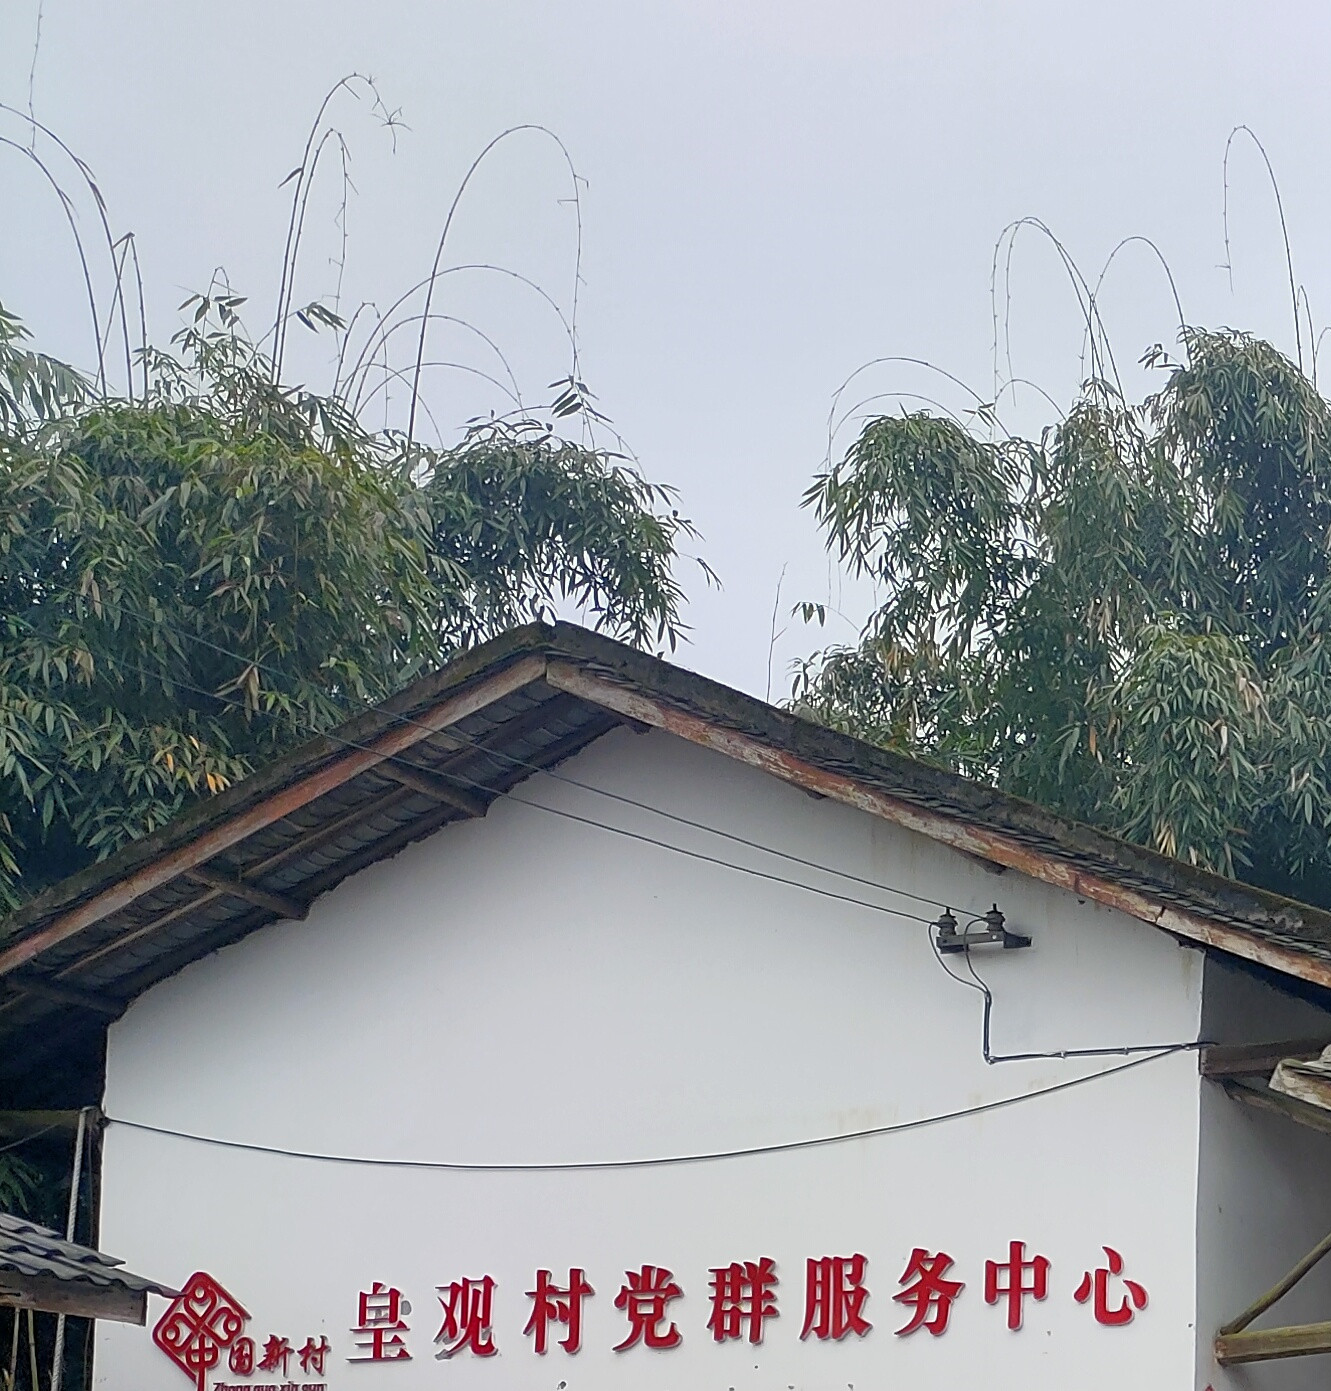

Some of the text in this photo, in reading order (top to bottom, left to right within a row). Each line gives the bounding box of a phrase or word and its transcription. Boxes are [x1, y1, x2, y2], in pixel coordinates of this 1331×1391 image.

[346, 1240, 1150, 1363] 皇观村党群服务中心
